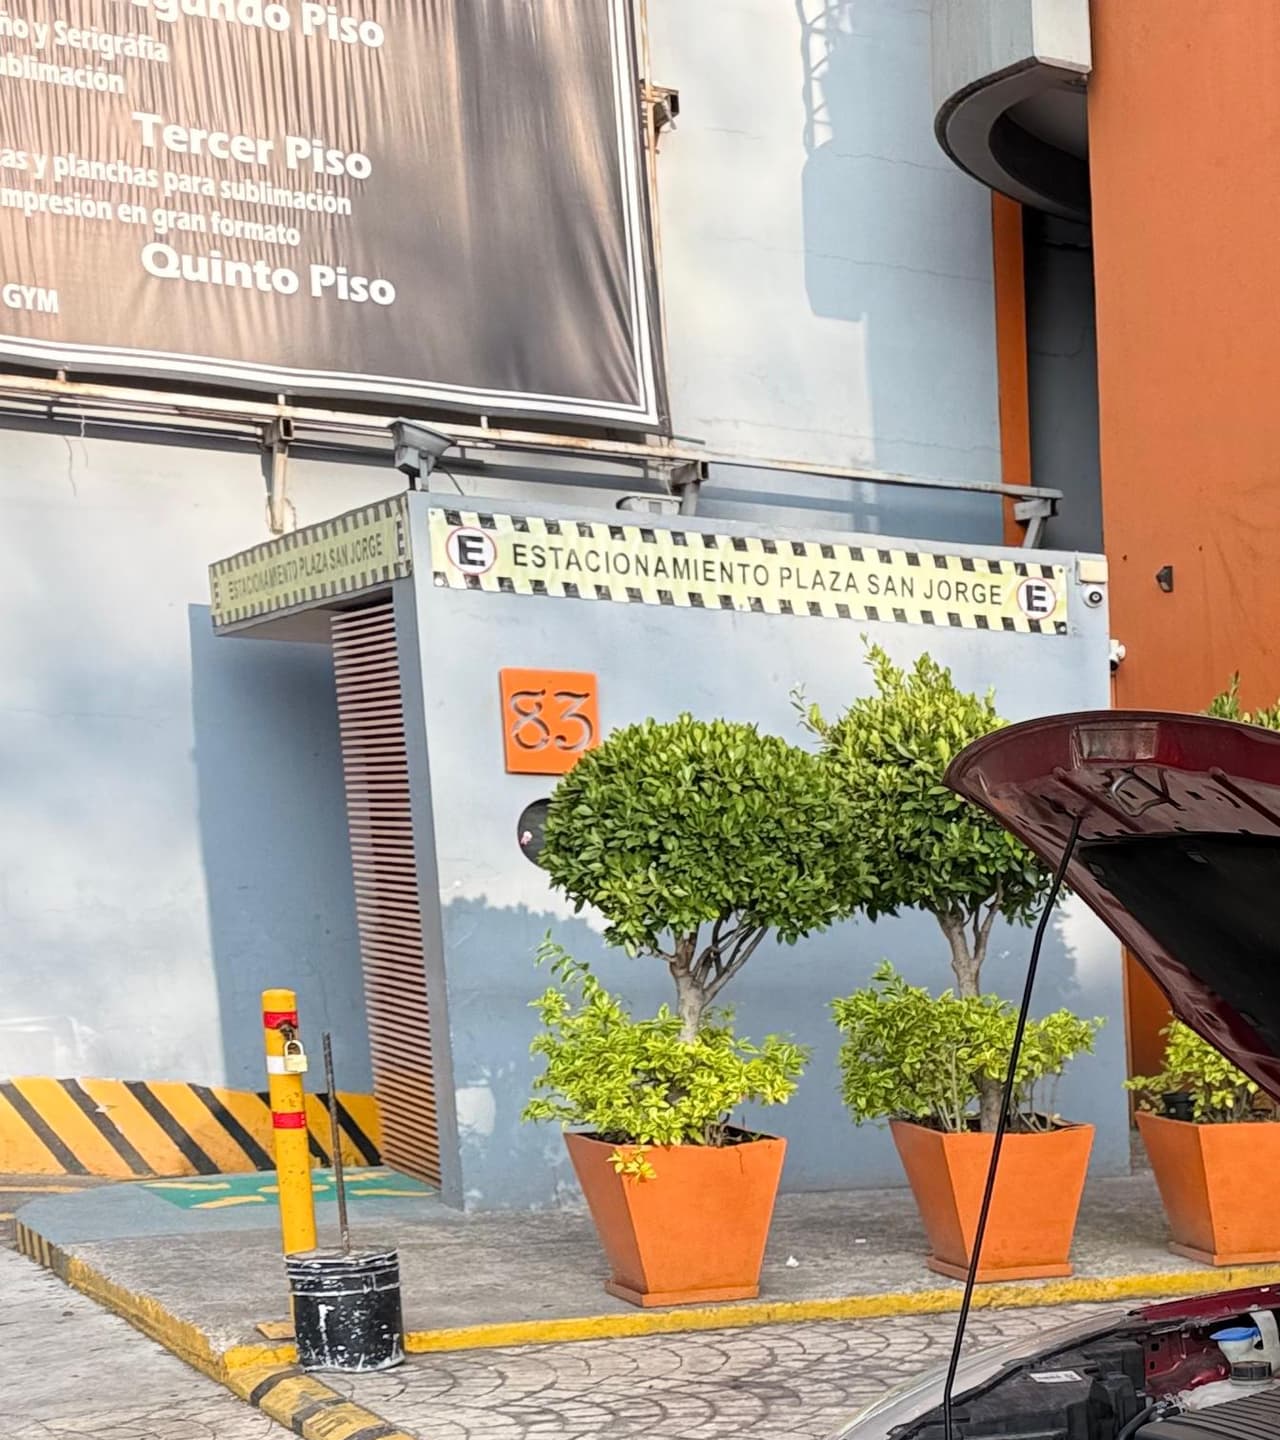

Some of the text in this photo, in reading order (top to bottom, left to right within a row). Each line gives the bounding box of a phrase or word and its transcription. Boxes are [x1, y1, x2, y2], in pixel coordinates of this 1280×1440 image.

[33, 21, 48, 50] y
[131, 0, 385, 48] gundo Piso
[132, 111, 372, 180] Tercer Piso
[33, 152, 48, 180] y
[54, 153, 159, 188] planchas
[164, 171, 215, 197] para
[220, 178, 352, 215] sublimación
[118, 202, 147, 224] en
[152, 208, 206, 234] gran
[211, 211, 301, 246] formato
[141, 242, 396, 306] Quinto Piso
[2, 283, 59, 314] GYM
[300, 549, 329, 577] PLAZA
[329, 544, 348, 569] SAN
[350, 533, 383, 565] JORGE
[458, 535, 486, 567] E
[513, 543, 1003, 606] ESTACIONAMIENTO PLAZA SAN JORGE
[1025, 584, 1048, 613] E
[510, 688, 594, 752] 83
